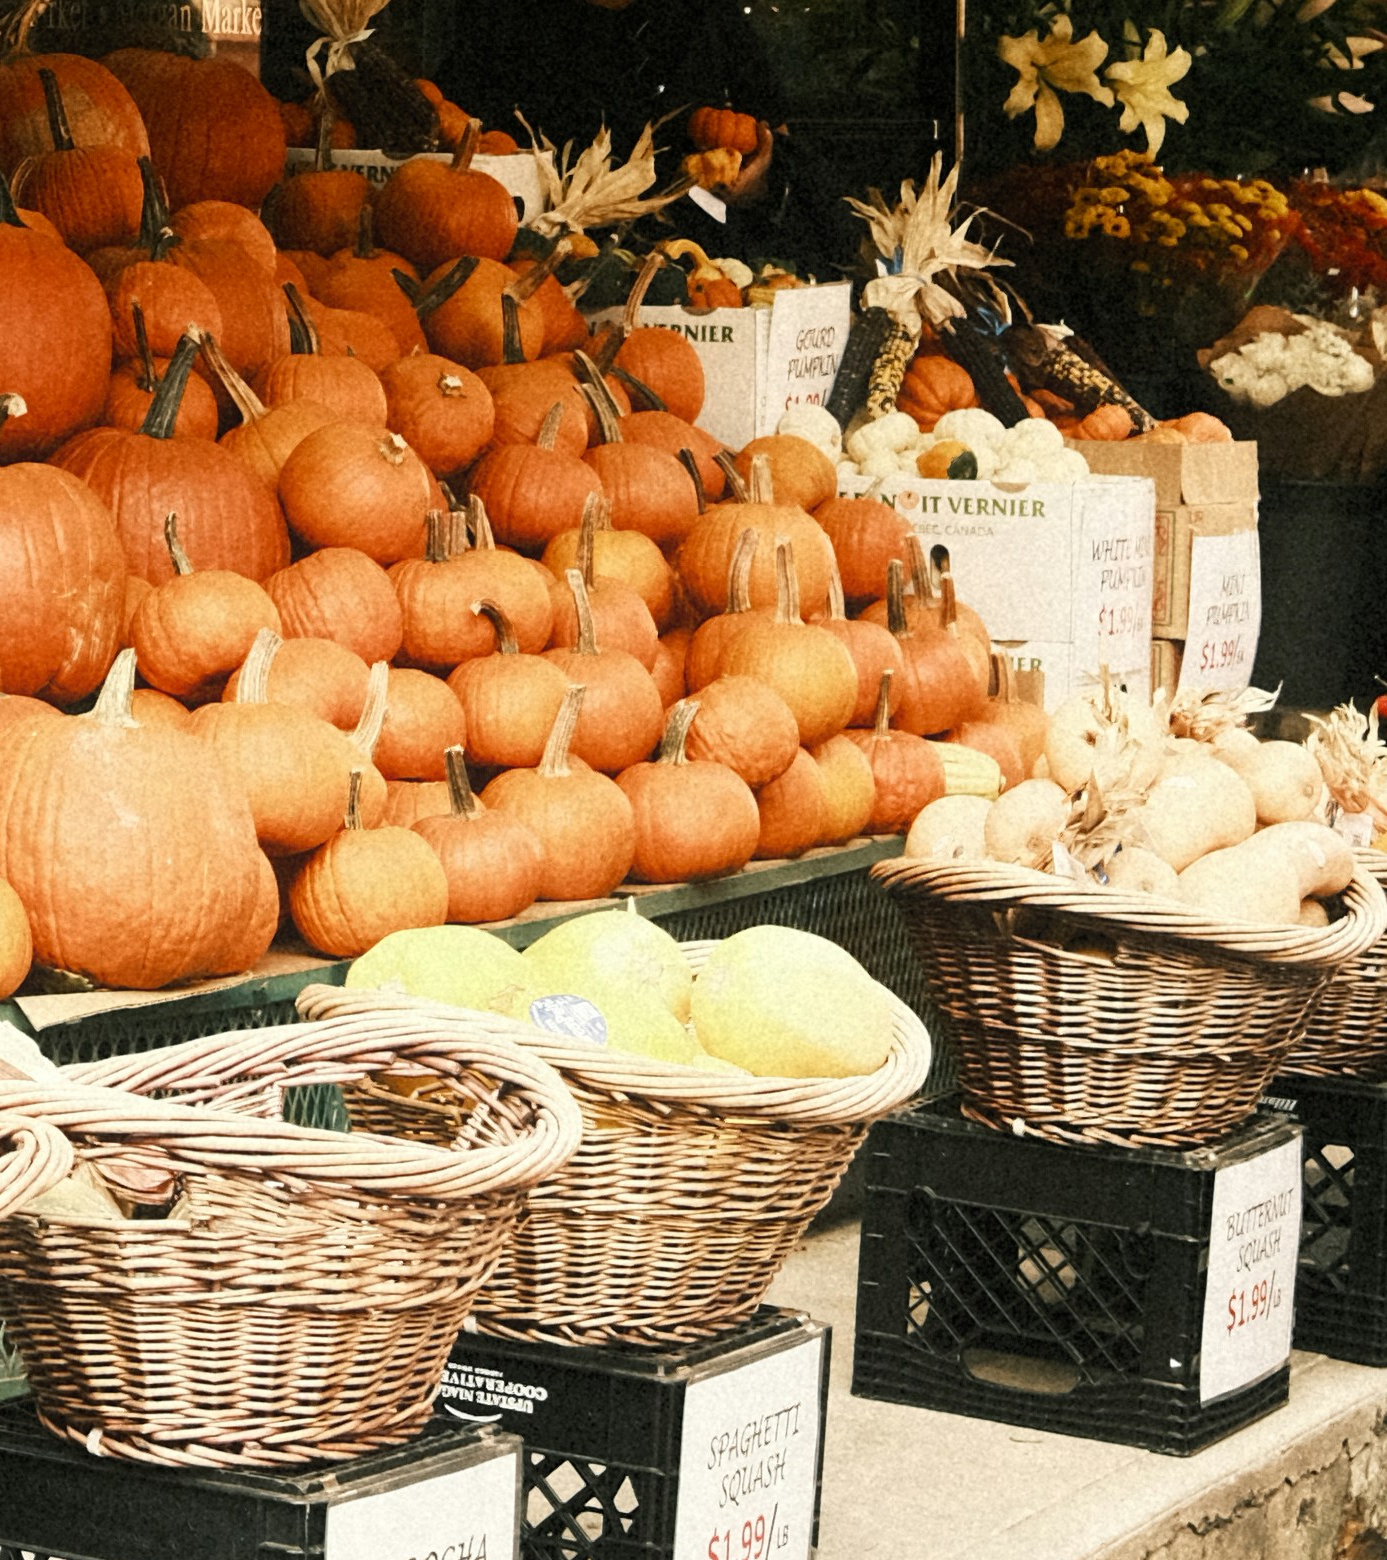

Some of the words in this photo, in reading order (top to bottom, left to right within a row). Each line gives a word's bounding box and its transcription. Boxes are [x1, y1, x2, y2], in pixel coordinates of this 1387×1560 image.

[795, 326, 836, 352] GOURD
[787, 353, 839, 381] PUMPKIN
[947, 496, 1046, 518] VERNIER
[1220, 573, 1246, 598] MINI
[1227, 1187, 1294, 1241] BUTTERNUT
[1236, 1230, 1282, 1273] SQUASH
[475, 1389, 535, 1415] UPSTATE
[707, 1402, 802, 1471] SPAGHETTI
[718, 1447, 788, 1509] SQUASH
